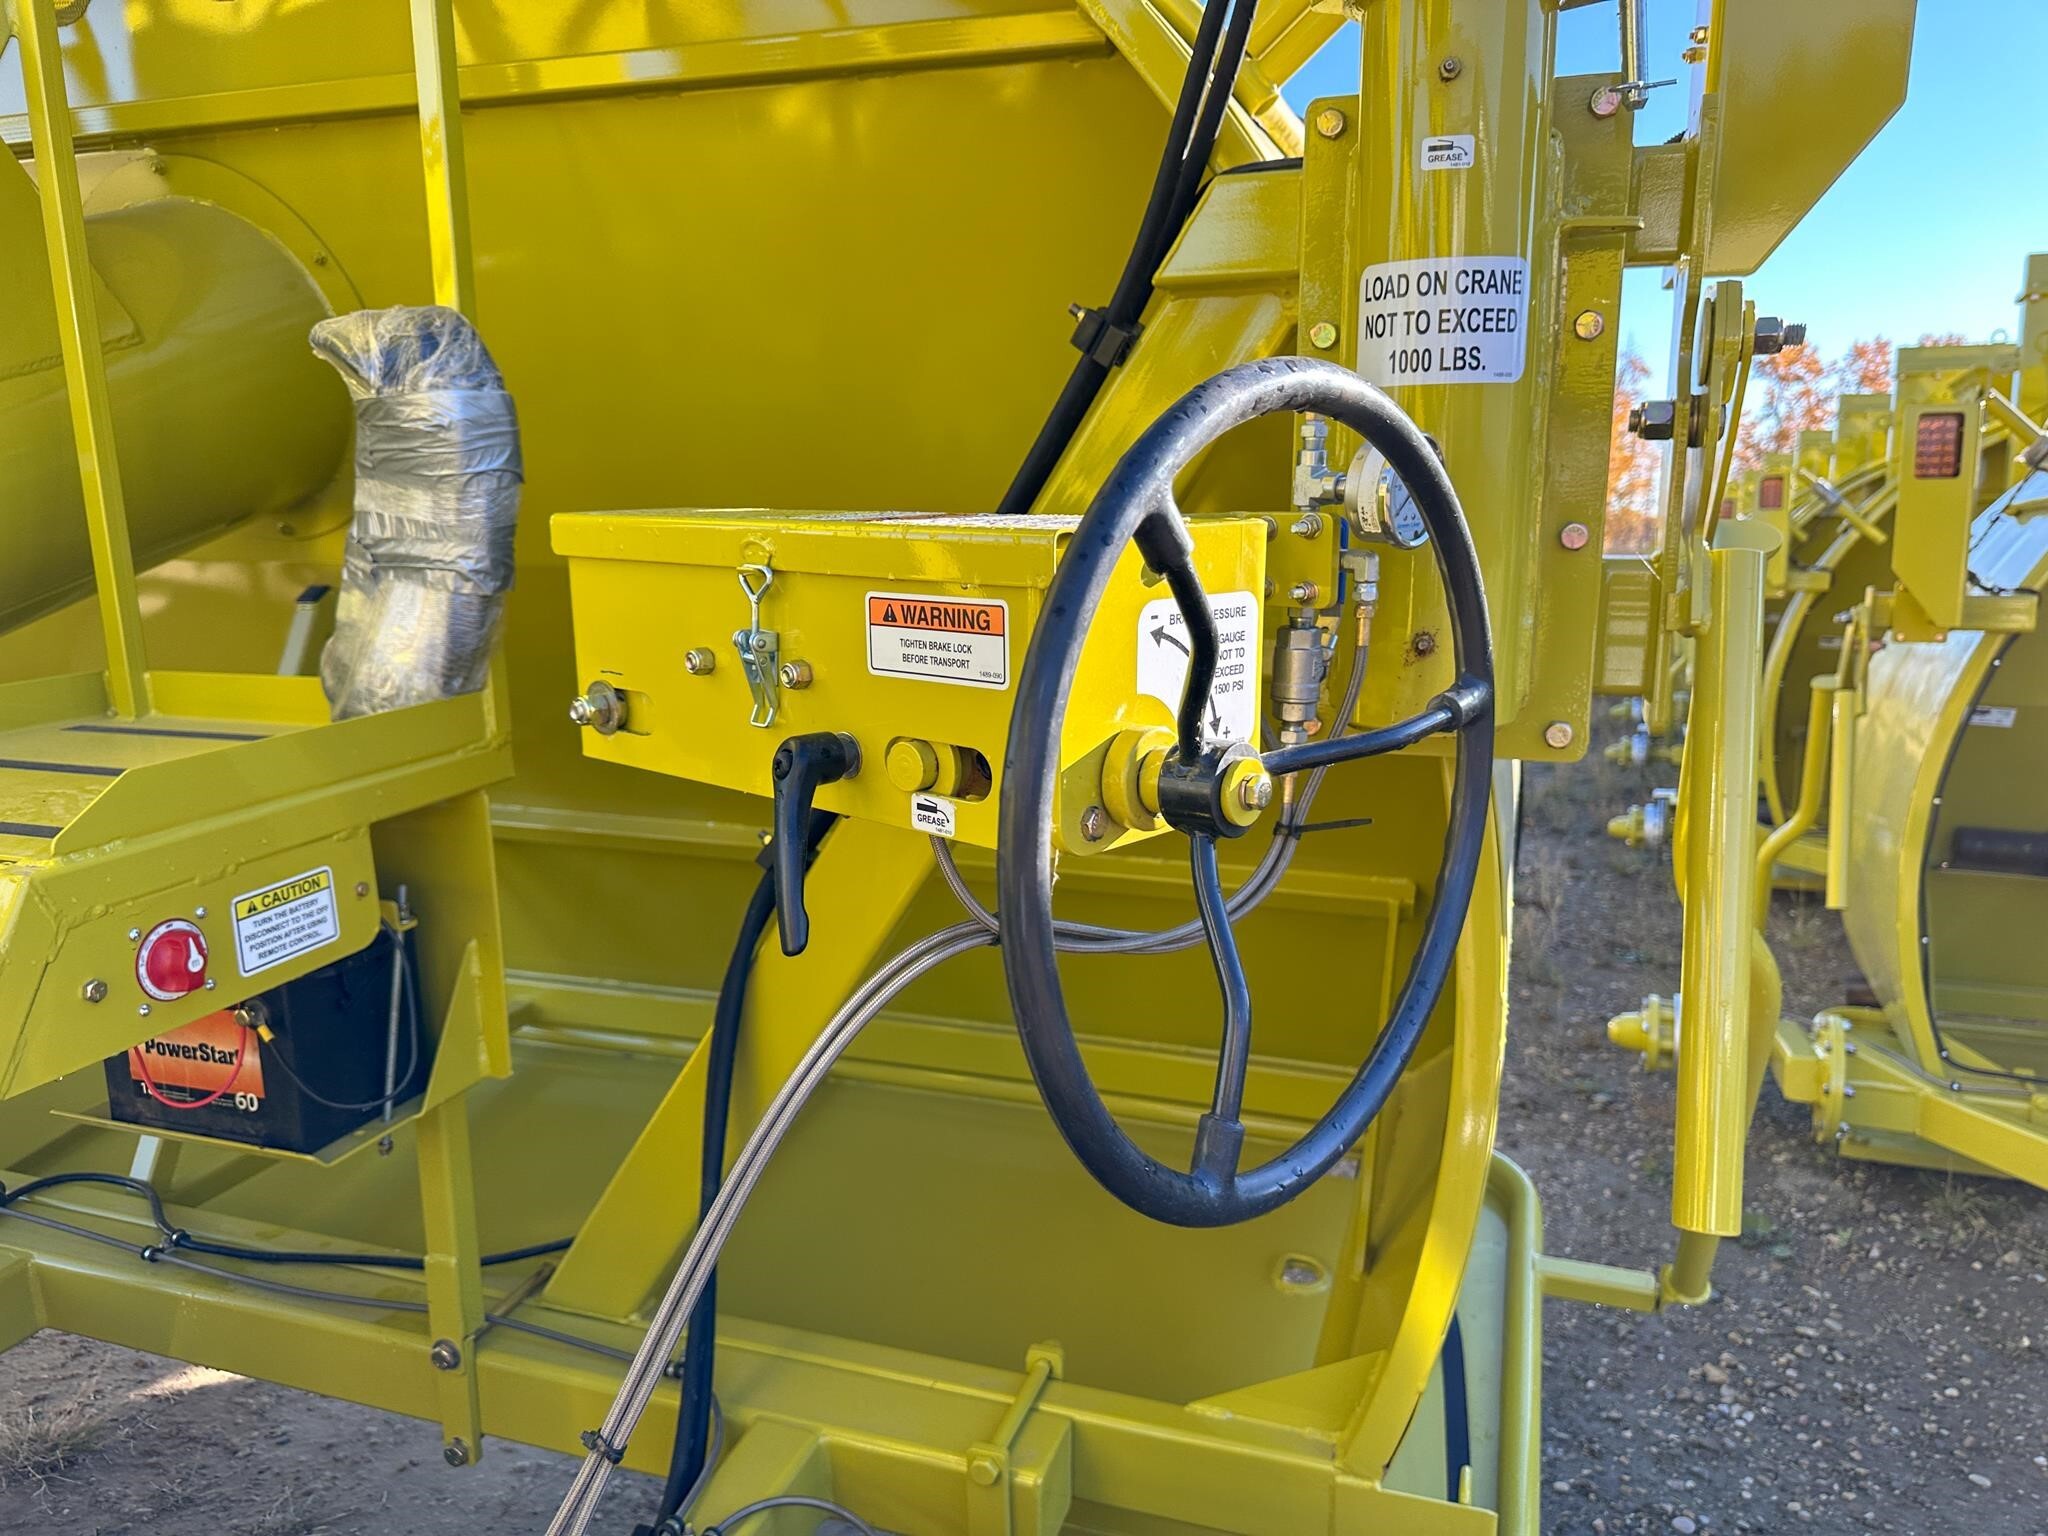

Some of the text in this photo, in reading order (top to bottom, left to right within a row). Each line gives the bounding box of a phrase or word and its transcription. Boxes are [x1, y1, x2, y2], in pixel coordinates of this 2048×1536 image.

[1428, 153, 1463, 163] GREASE
[1365, 269, 1522, 302] LOAD ON CRANE
[1365, 308, 1518, 340] NOT TO EXCEED
[1389, 346, 1486, 375] 1000 LBS.
[901, 604, 991, 631] WARNING
[1213, 606, 1247, 620] ESSURE
[1219, 630, 1246, 644] GAUGE
[900, 638, 972, 654] TIGHTEN BRAKE LOCK
[1235, 647, 1245, 658] TO
[902, 653, 970, 669] BEFORE TRANSPORT
[1214, 664, 1245, 678] EXCEED
[1214, 680, 1244, 695] 1500 PSI
[917, 813, 946, 828] GREASE
[261, 877, 321, 908] CAUTION
[253, 897, 319, 928] TURN THE BATTERY
[244, 904, 330, 943] DISCONNECT TO THE OFF
[249, 915, 328, 952] POSITION AFTER USING
[258, 943, 288, 960] REMOTE
[235, 1092, 259, 1113] 60
